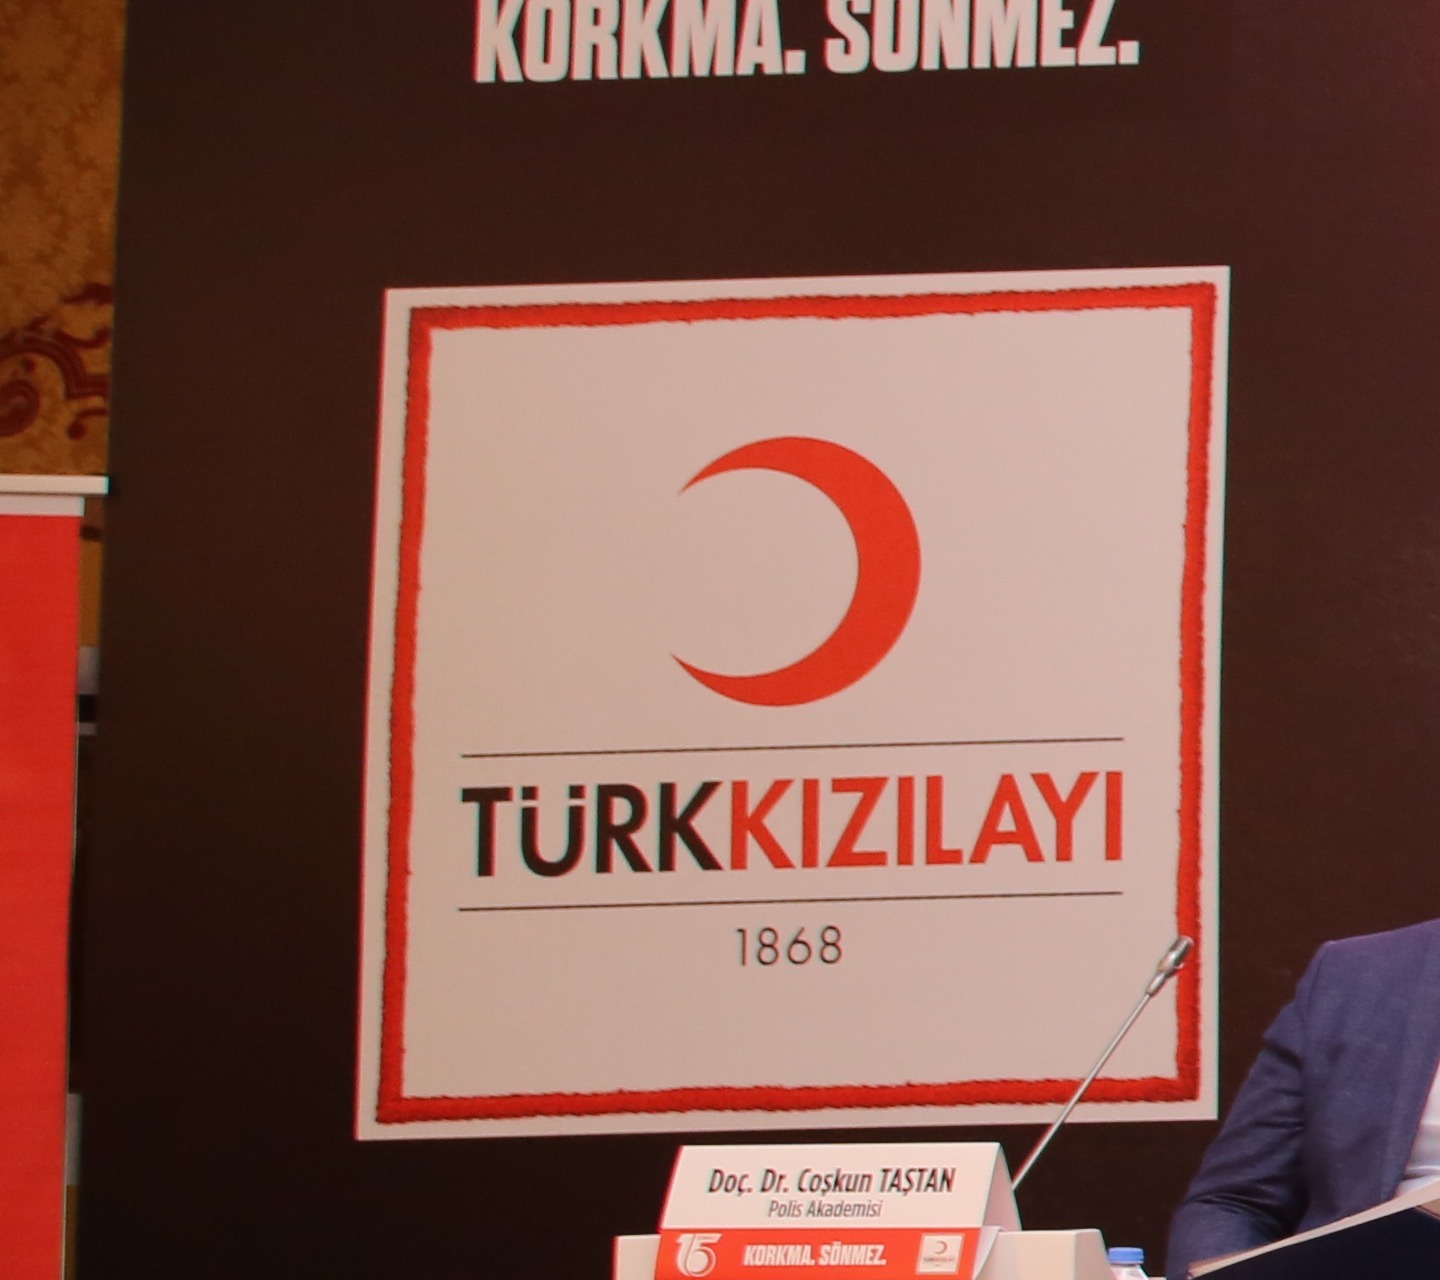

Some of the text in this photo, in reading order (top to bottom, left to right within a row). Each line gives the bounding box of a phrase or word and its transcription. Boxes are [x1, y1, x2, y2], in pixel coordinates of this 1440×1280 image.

[461, 771, 1123, 878] TÜRKKIZILAYI
[736, 925, 844, 967] 1868
[708, 1167, 957, 1197] Doç. Dr. Coşkun TAŞTAN
[767, 1200, 883, 1218] Polis Akademisi
[743, 1241, 887, 1266] KORKMA. SÖNMEZ.
